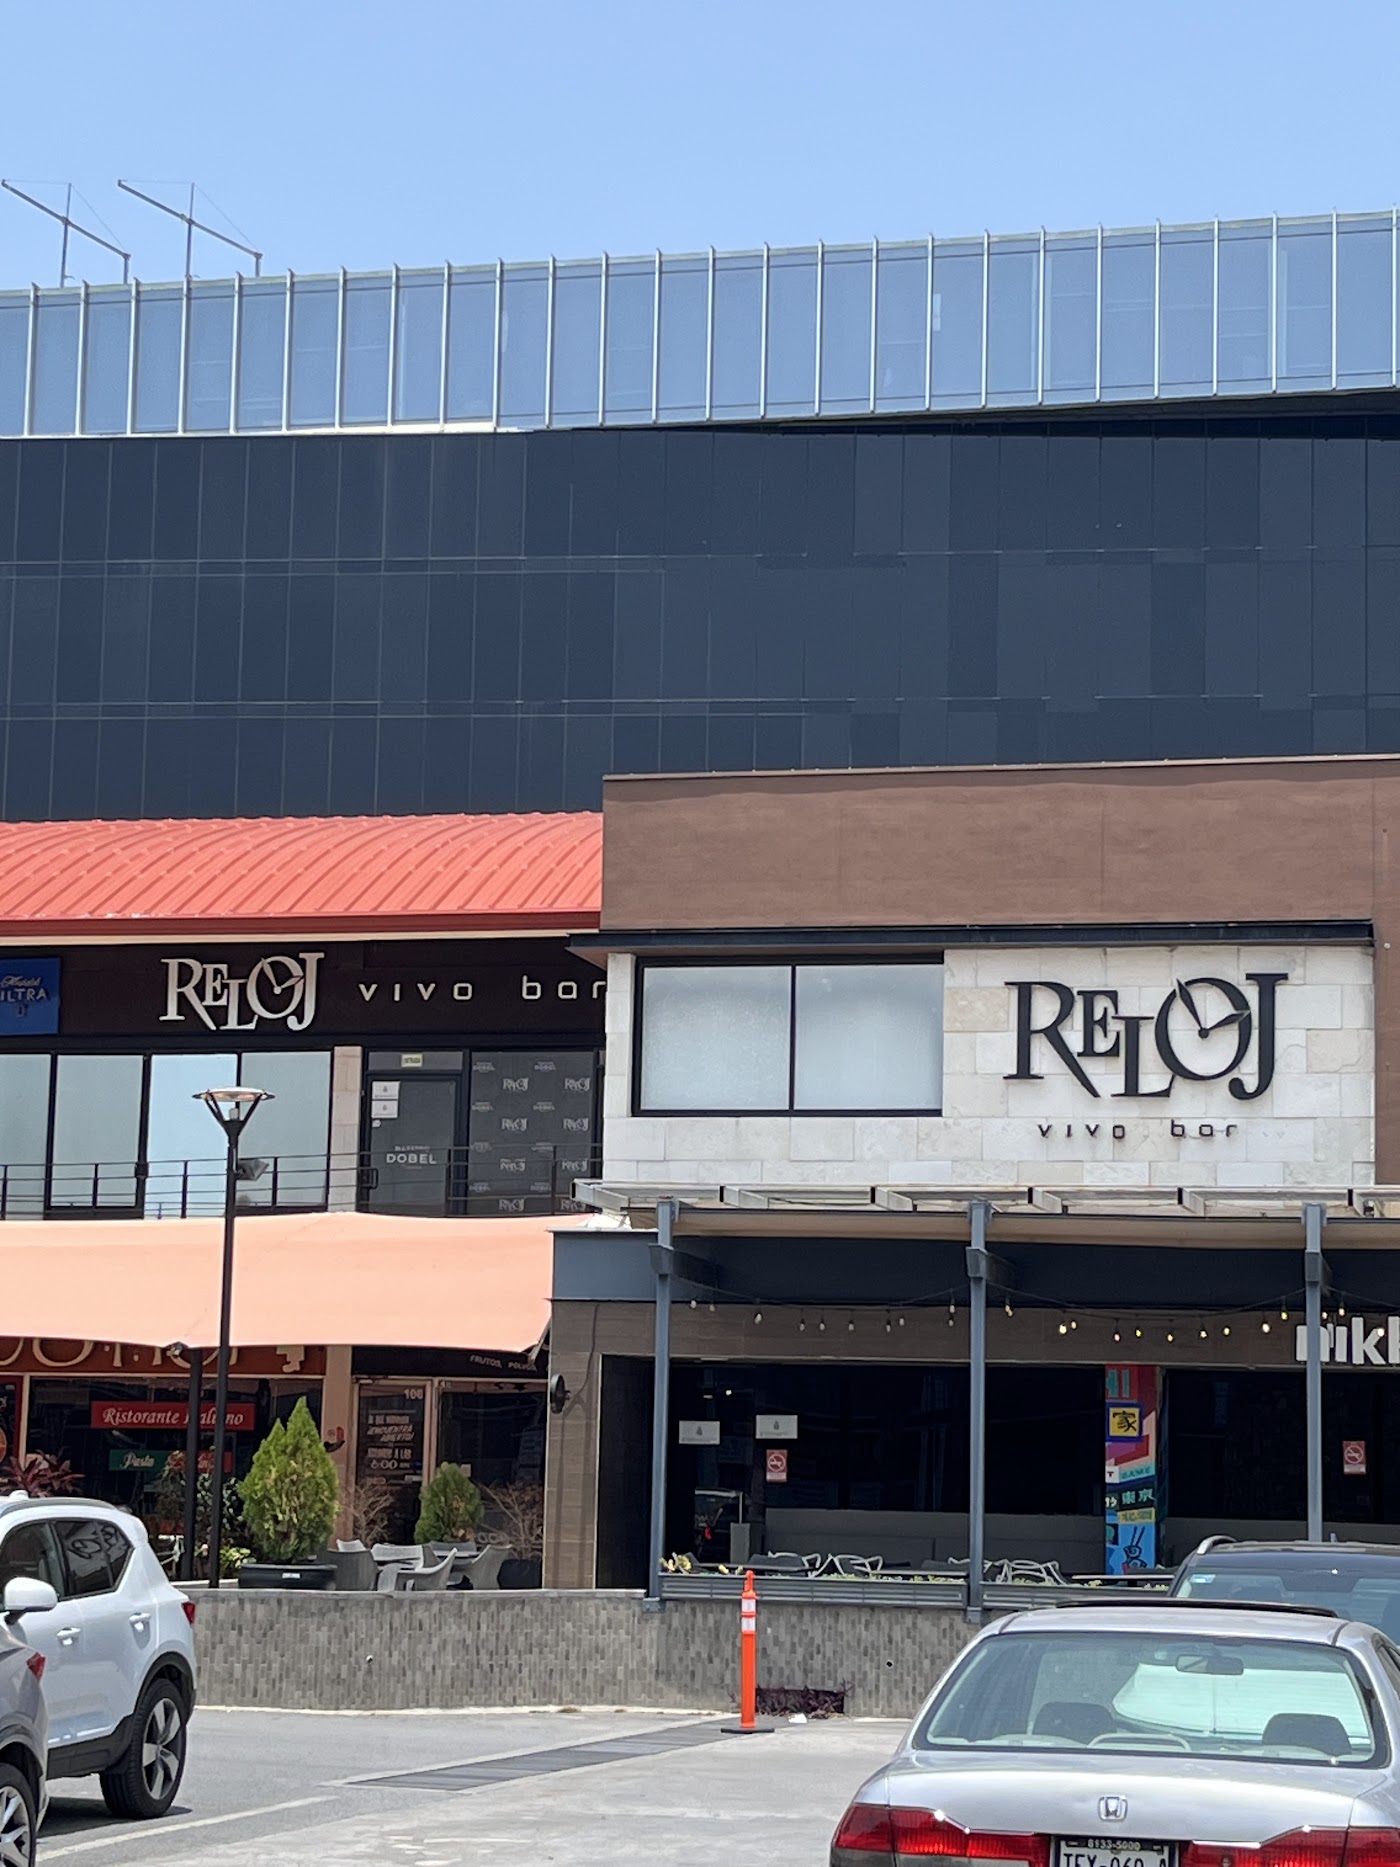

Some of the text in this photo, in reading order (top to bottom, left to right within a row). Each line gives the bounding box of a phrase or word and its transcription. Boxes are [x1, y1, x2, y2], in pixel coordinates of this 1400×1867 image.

[159, 952, 325, 1031] RELOJ
[358, 974, 607, 1002] vivo bar
[1003, 973, 1288, 1101] RELOJ
[1038, 1119, 1237, 1139] vivo bar
[103, 1406, 244, 1426] Ristorante alino
[1112, 1410, 1137, 1433] 家
